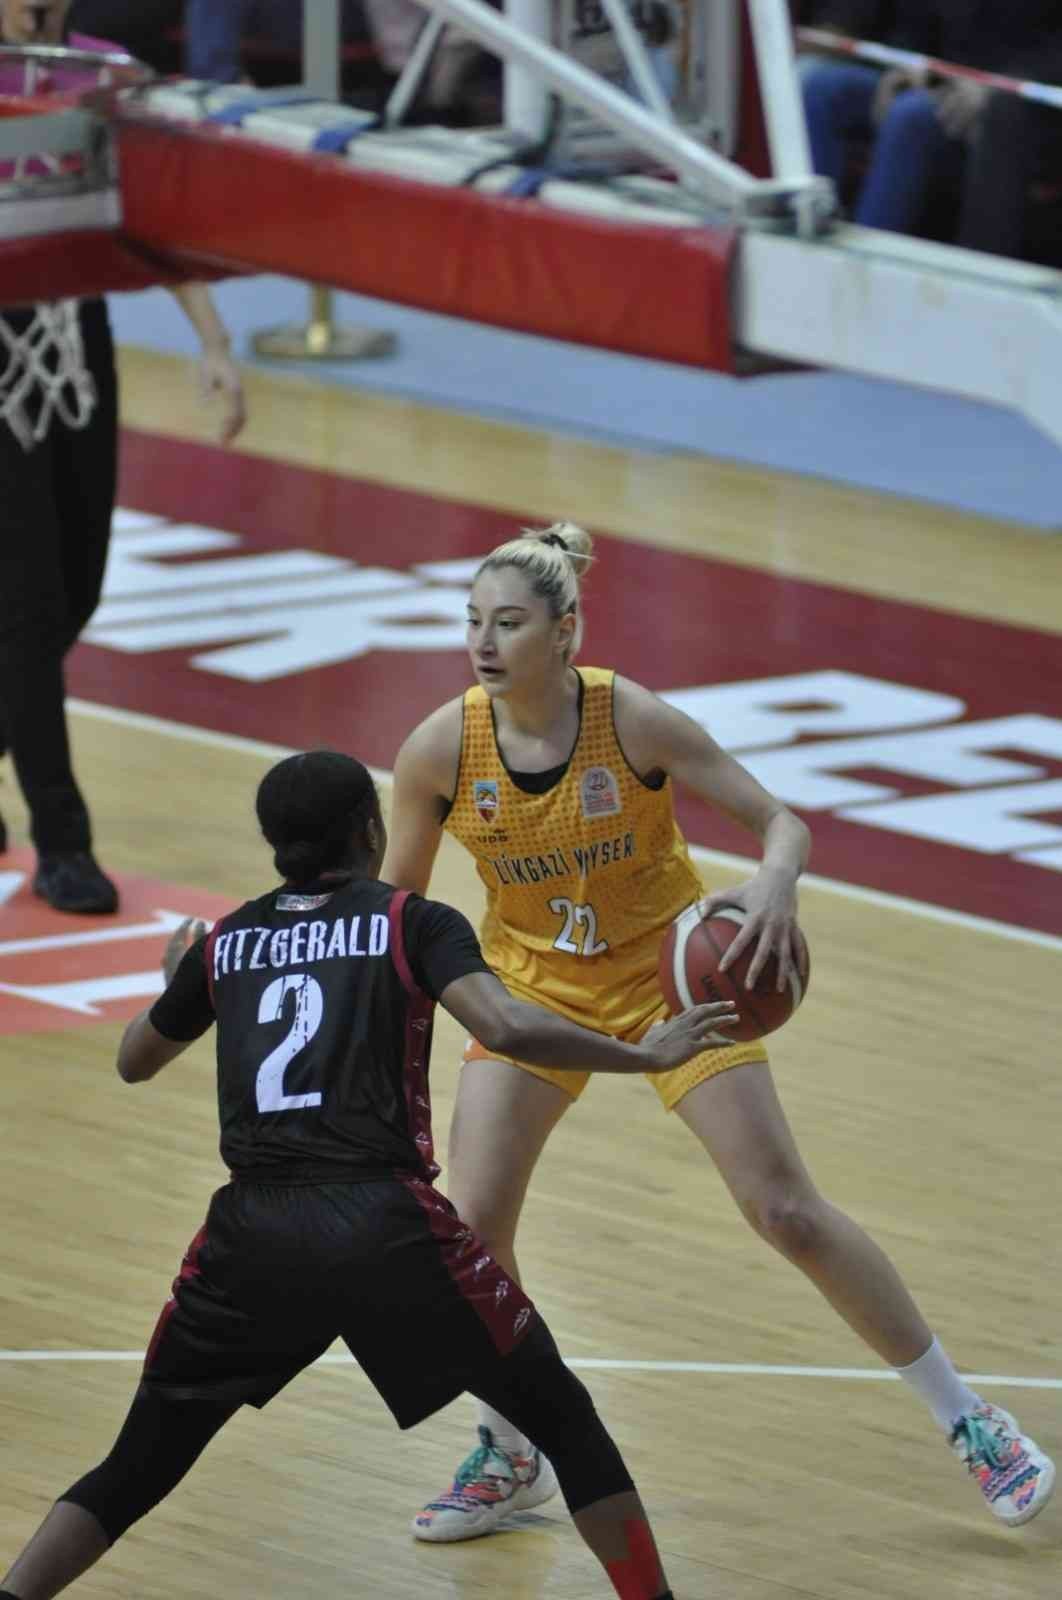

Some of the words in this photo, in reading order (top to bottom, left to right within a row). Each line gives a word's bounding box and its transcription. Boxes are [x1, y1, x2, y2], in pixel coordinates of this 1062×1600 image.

[492, 847, 572, 885] LİKGAZİ
[213, 912, 391, 981] FITZGERALD
[547, 896, 609, 957] 22
[255, 973, 324, 1114] 2
